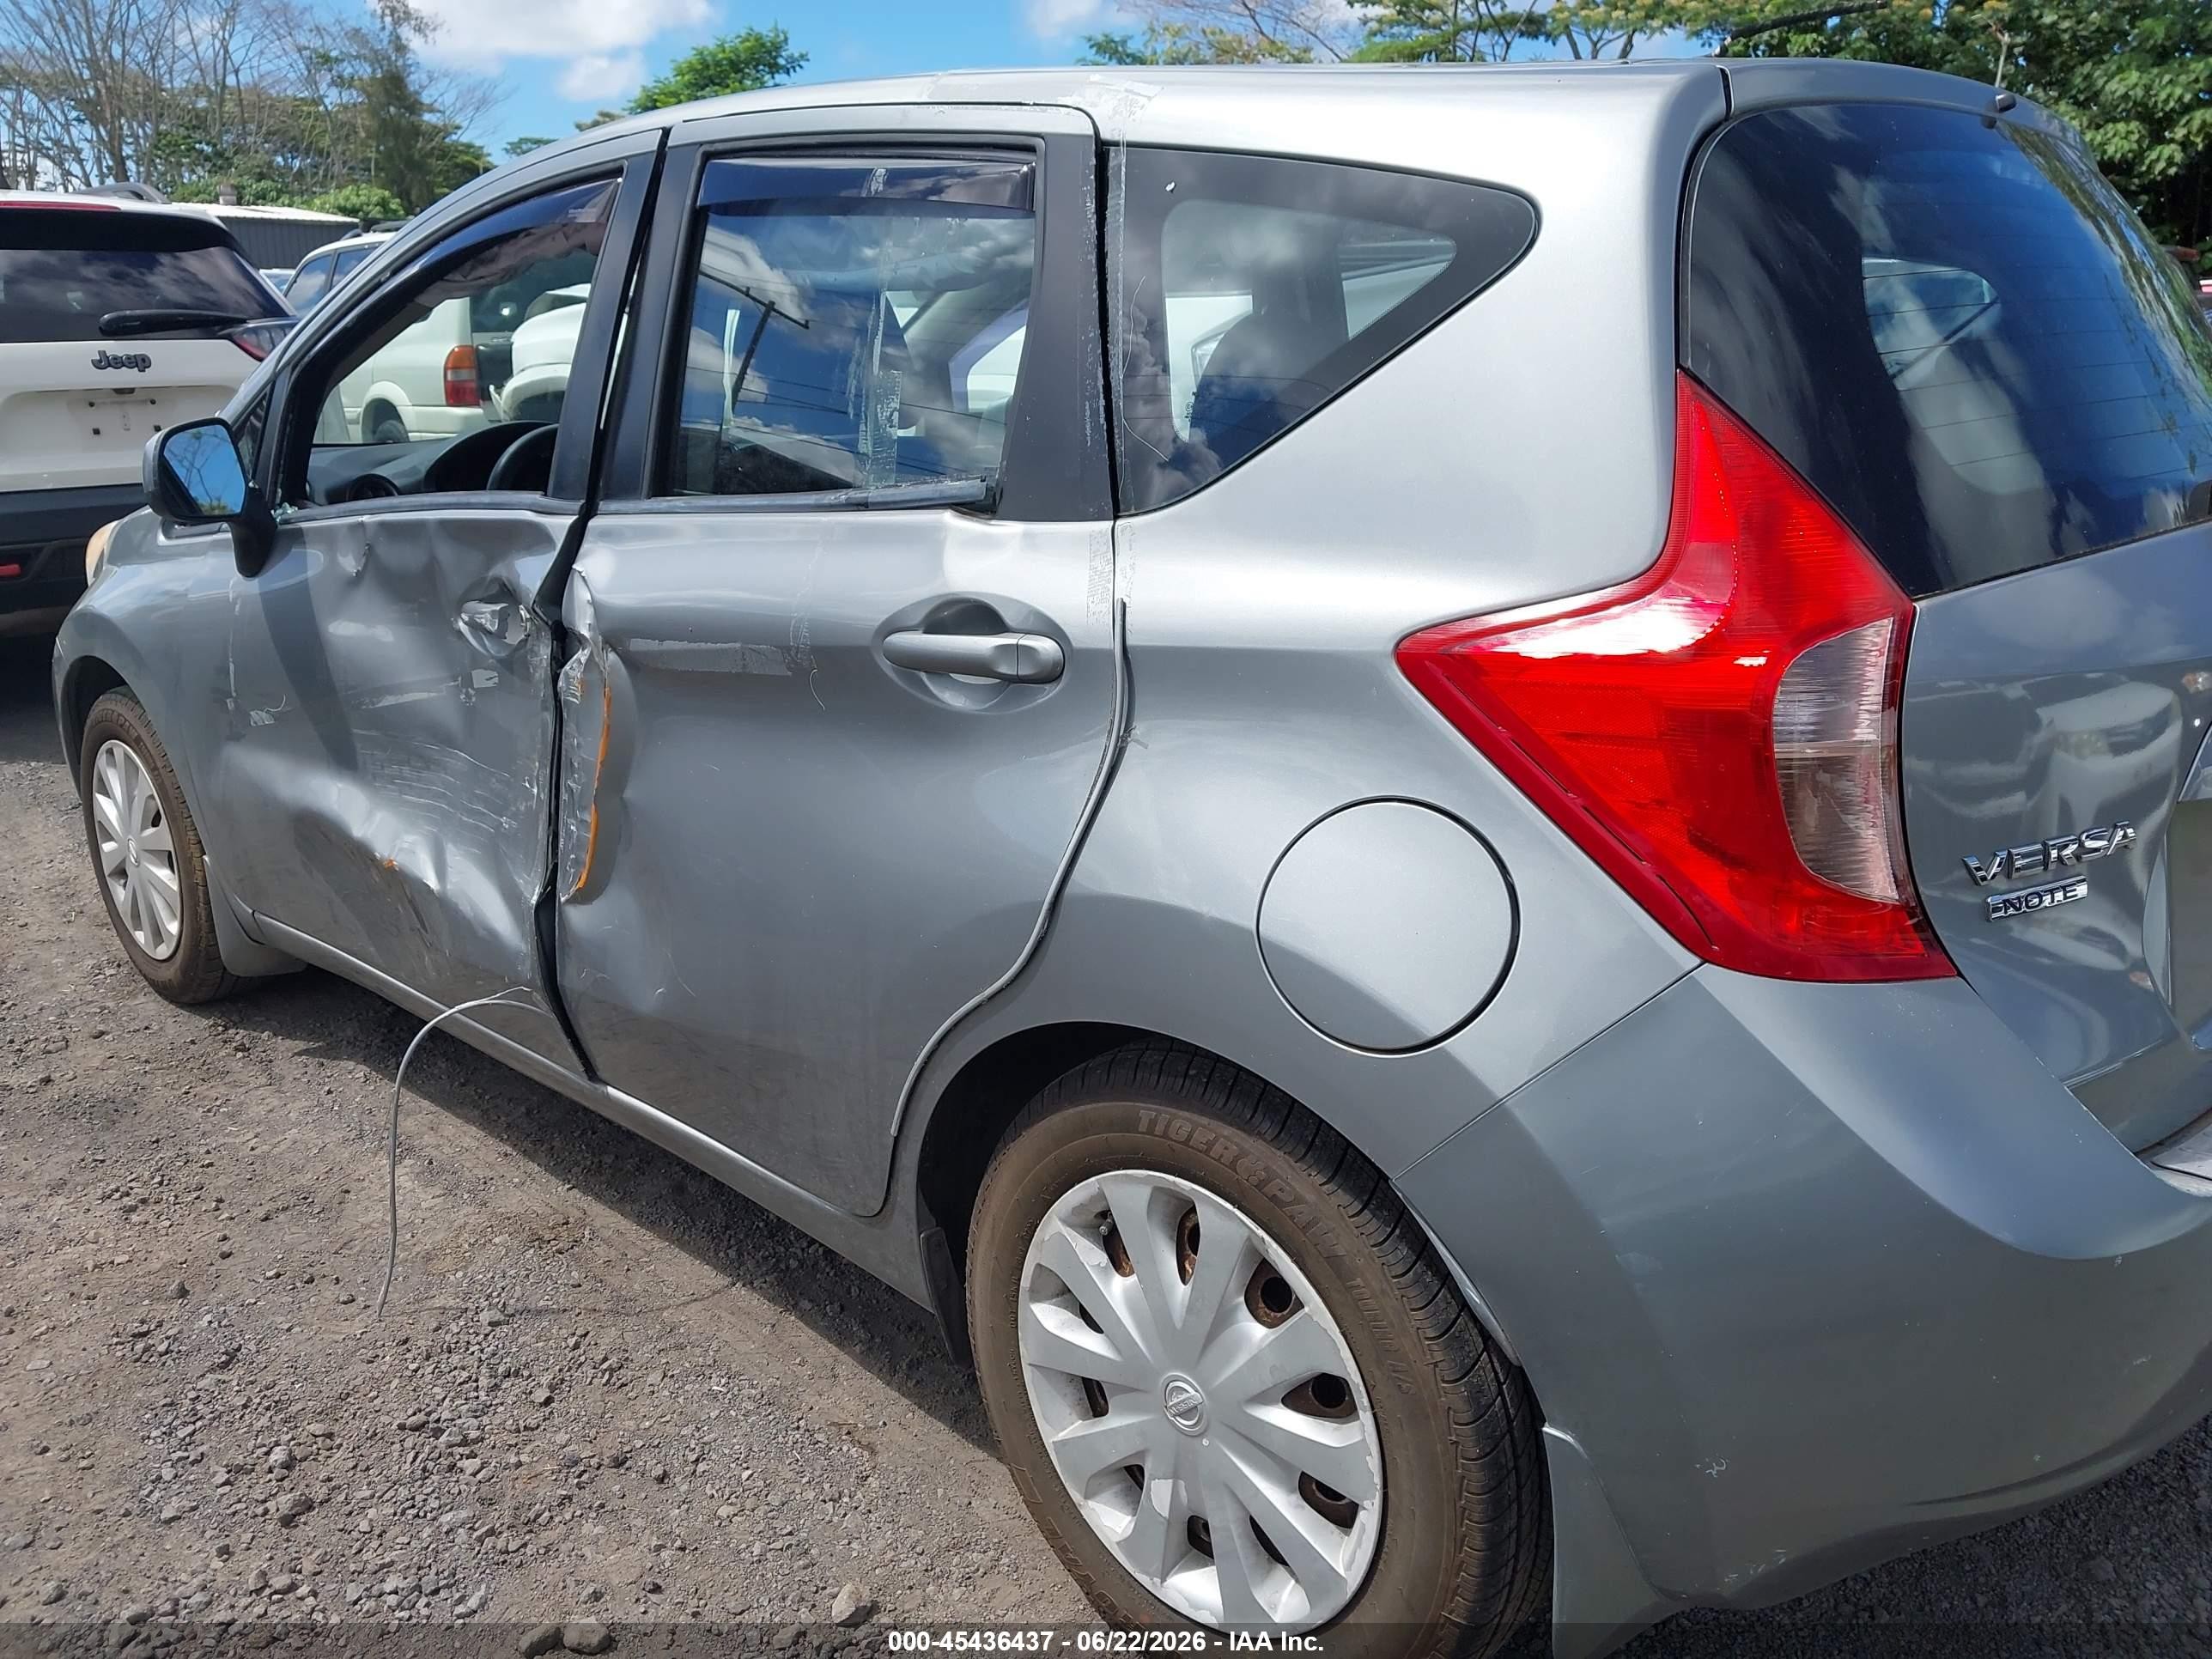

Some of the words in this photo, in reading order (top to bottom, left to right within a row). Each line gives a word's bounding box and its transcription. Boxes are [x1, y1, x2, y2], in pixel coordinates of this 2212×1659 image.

[91, 350, 151, 373] Jeep
[1961, 821, 2136, 885] VERSA
[2001, 883, 2080, 915] NOTE
[1138, 1109, 1239, 1165] TIGER
[1262, 1178, 1347, 1259] PAW
